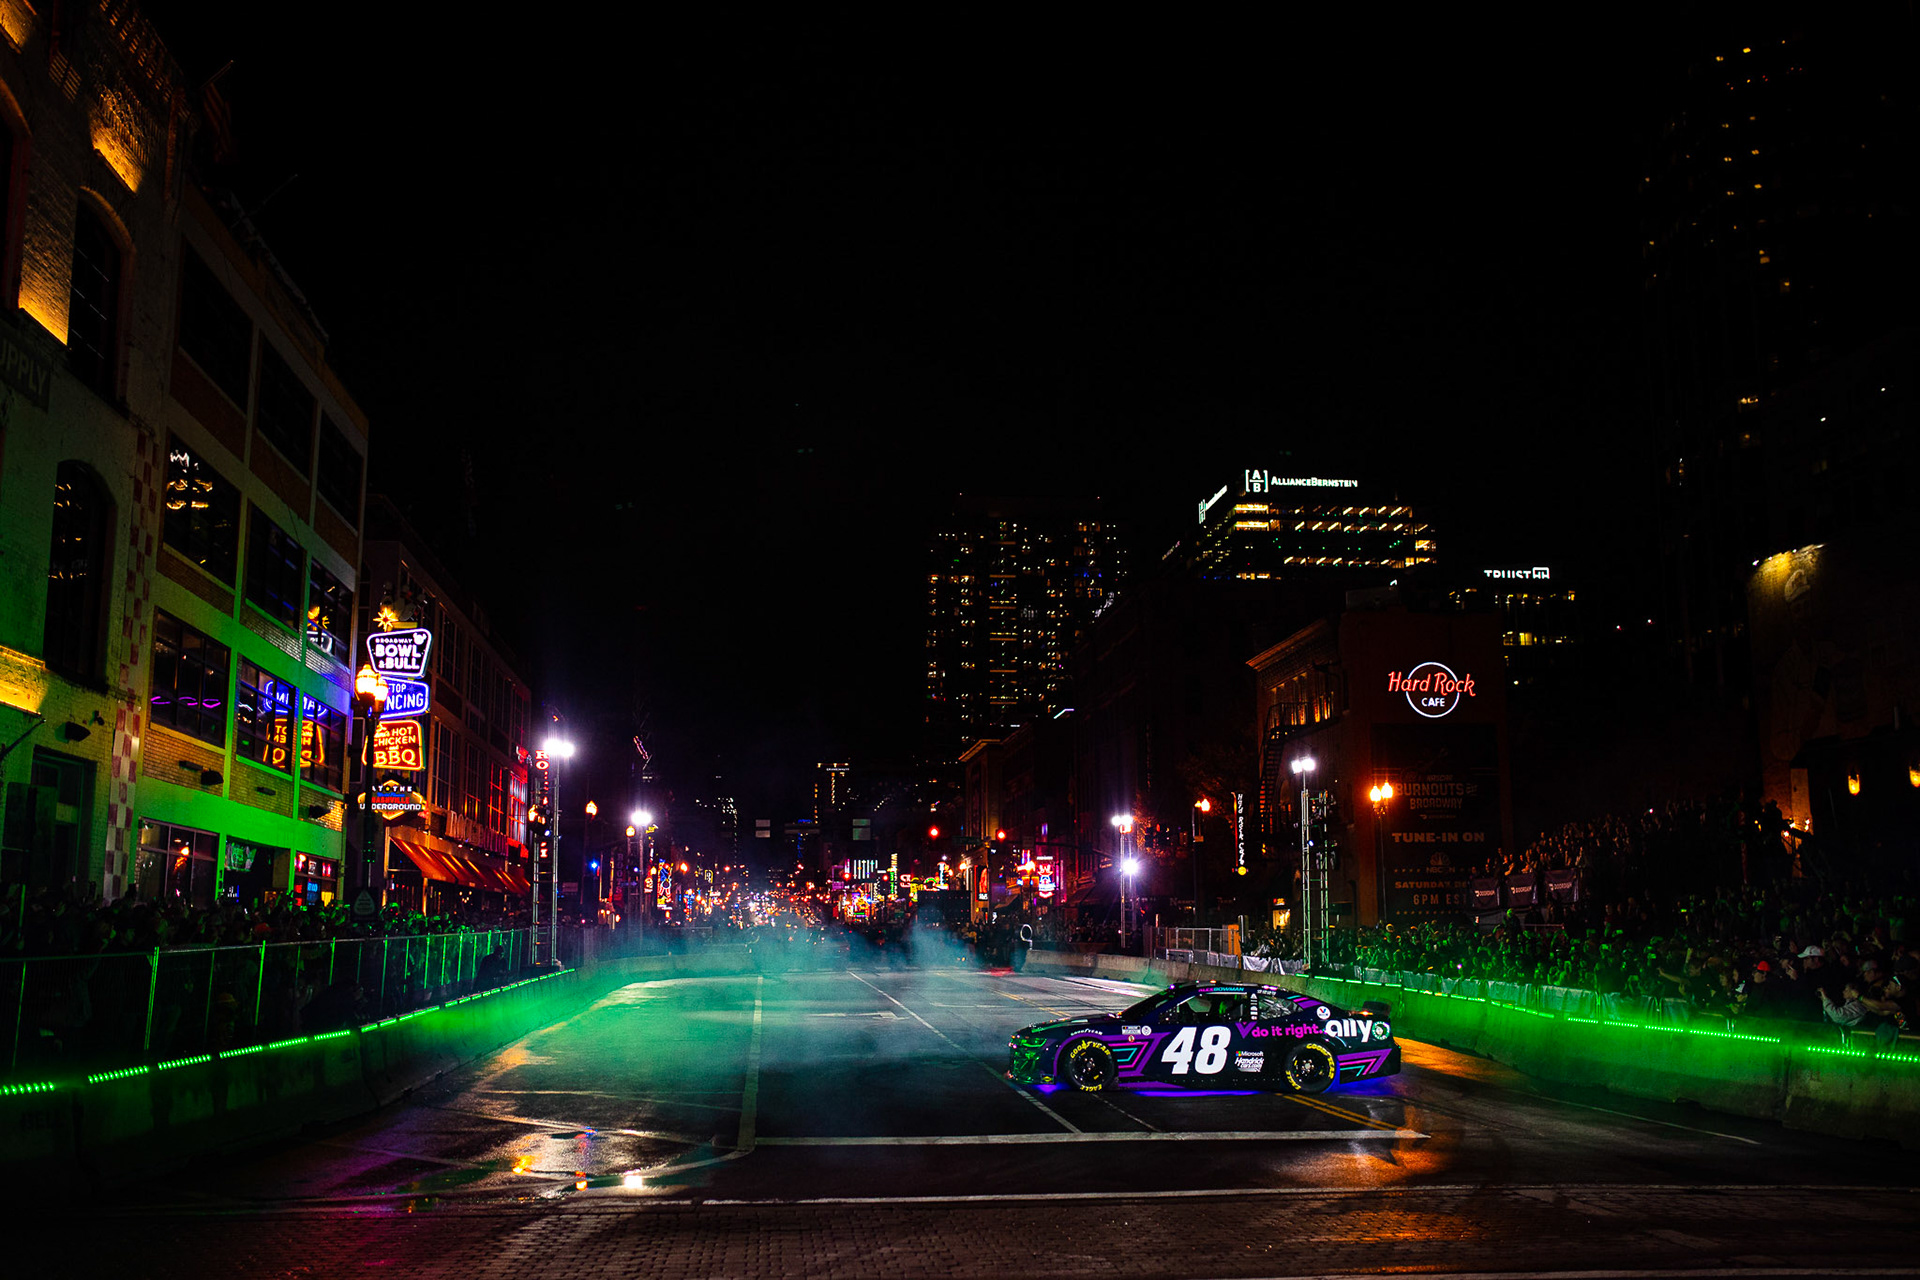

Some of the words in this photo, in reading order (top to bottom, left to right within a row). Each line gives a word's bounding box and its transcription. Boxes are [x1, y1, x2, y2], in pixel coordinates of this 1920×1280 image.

[375, 643, 422, 658] BOWL
[385, 656, 420, 669] BULL
[1388, 671, 1431, 692] Hard
[1433, 671, 1476, 697] Rock
[386, 692, 424, 711] NCING
[1421, 697, 1446, 707] CAFE
[392, 726, 414, 737] HOT
[374, 749, 417, 766] BBQ
[1396, 782, 1464, 797] BURNOUTS
[359, 802, 422, 811] UDERGROUND
[1409, 796, 1463, 811] BROADWAY
[1391, 832, 1459, 843] TUNE-IN
[1461, 832, 1485, 843] ON
[1394, 880, 1452, 890] SATURDAY
[1412, 893, 1440, 906] 6PM
[1251, 1026, 1269, 1038] do
[1271, 1025, 1282, 1037] it
[1325, 1017, 1373, 1043] ally
[1069, 1040, 1112, 1059] GOODYEAR
[1161, 1025, 1231, 1075] 48
